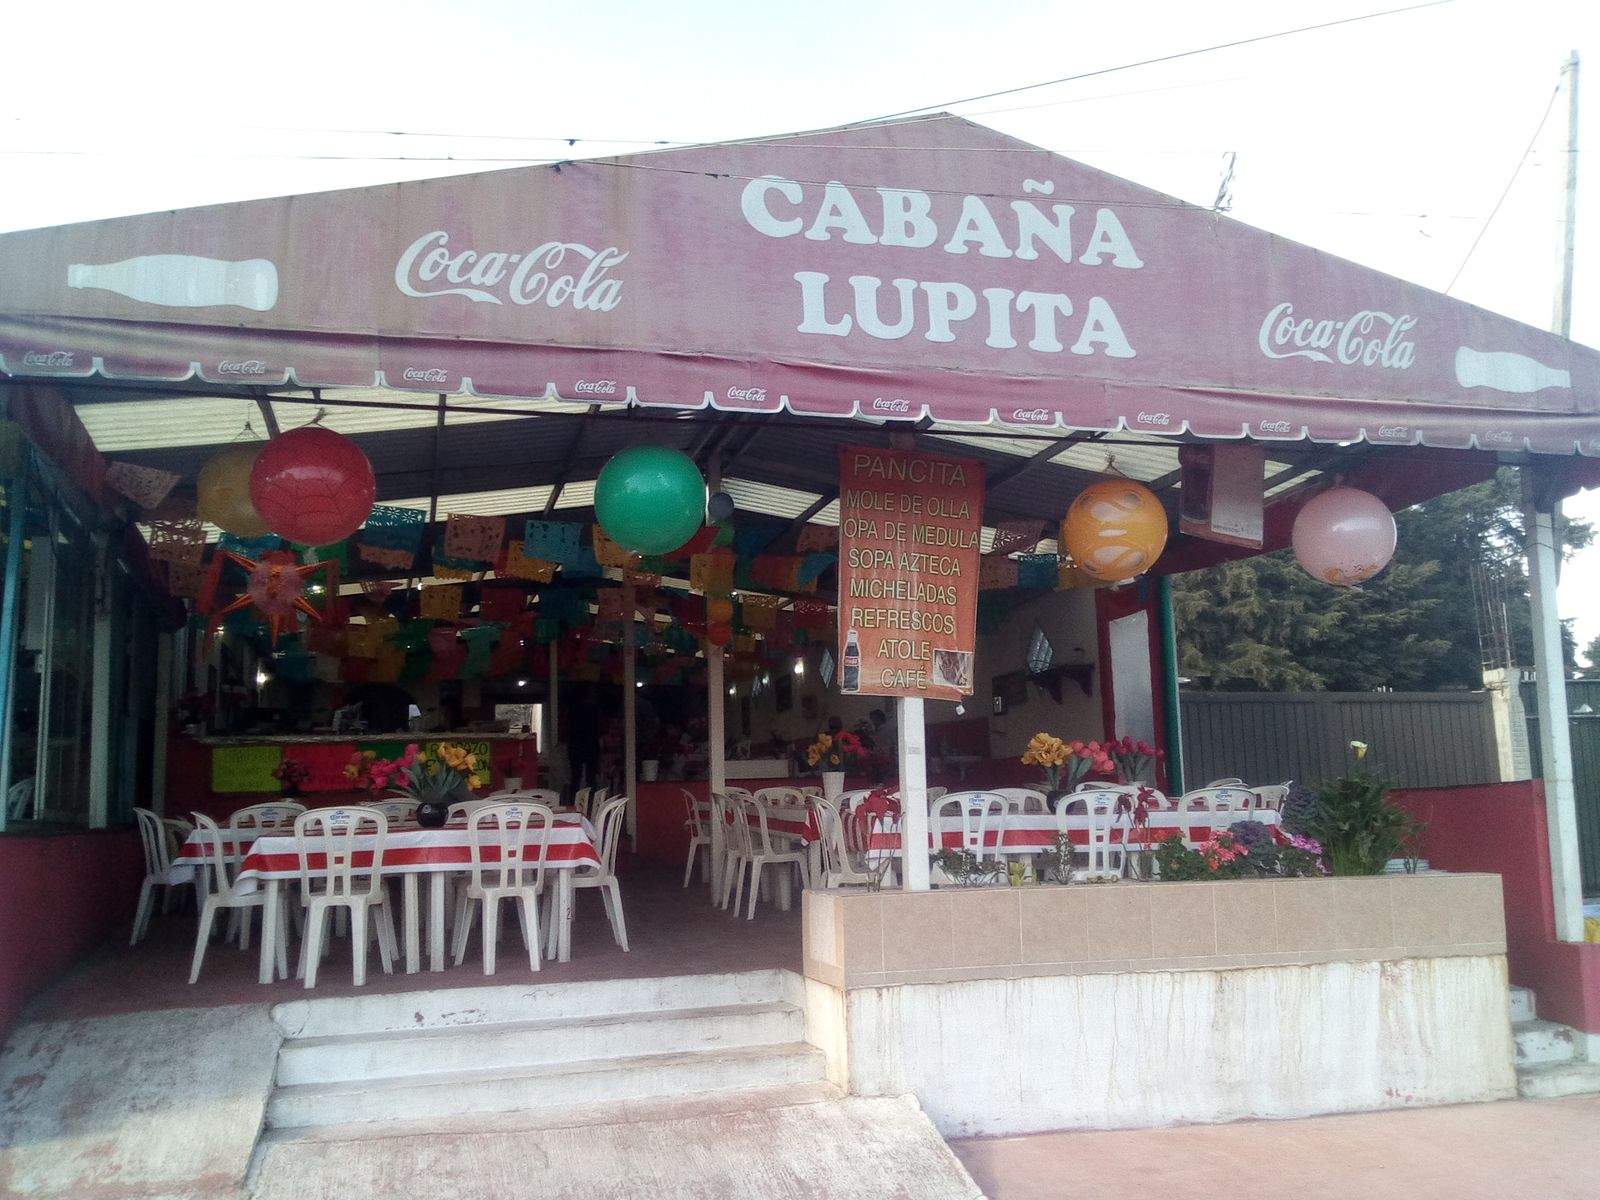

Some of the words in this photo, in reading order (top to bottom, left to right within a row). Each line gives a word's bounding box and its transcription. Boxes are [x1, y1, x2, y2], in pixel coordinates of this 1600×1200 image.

[740, 174, 1145, 270] CABAÑA
[394, 229, 631, 313] Coca-Cola
[793, 270, 1138, 360] LUPITA
[1258, 301, 1419, 371] Coca-Cola
[402, 366, 449, 384] Coca-Cola
[574, 379, 617, 395] Coca-Cola
[727, 385, 768, 402] Coca-Cola
[872, 397, 911, 413] Coca-Cola
[1012, 408, 1049, 422] Coca-Cola
[853, 454, 968, 487] PANCITA
[846, 489, 895, 512] MOLE
[899, 493, 923, 515] DE
[927, 496, 971, 519] OLLA
[841, 518, 879, 541] OPA
[884, 520, 908, 543] DE
[912, 525, 980, 550] MEDULA
[848, 548, 896, 571] SOPA
[898, 551, 962, 577] AZTECA
[849, 577, 958, 606] MICHELADAS
[851, 607, 956, 635] REFRESCOS
[877, 638, 932, 662] ATOLE
[881, 665, 928, 690] CAFÉ
